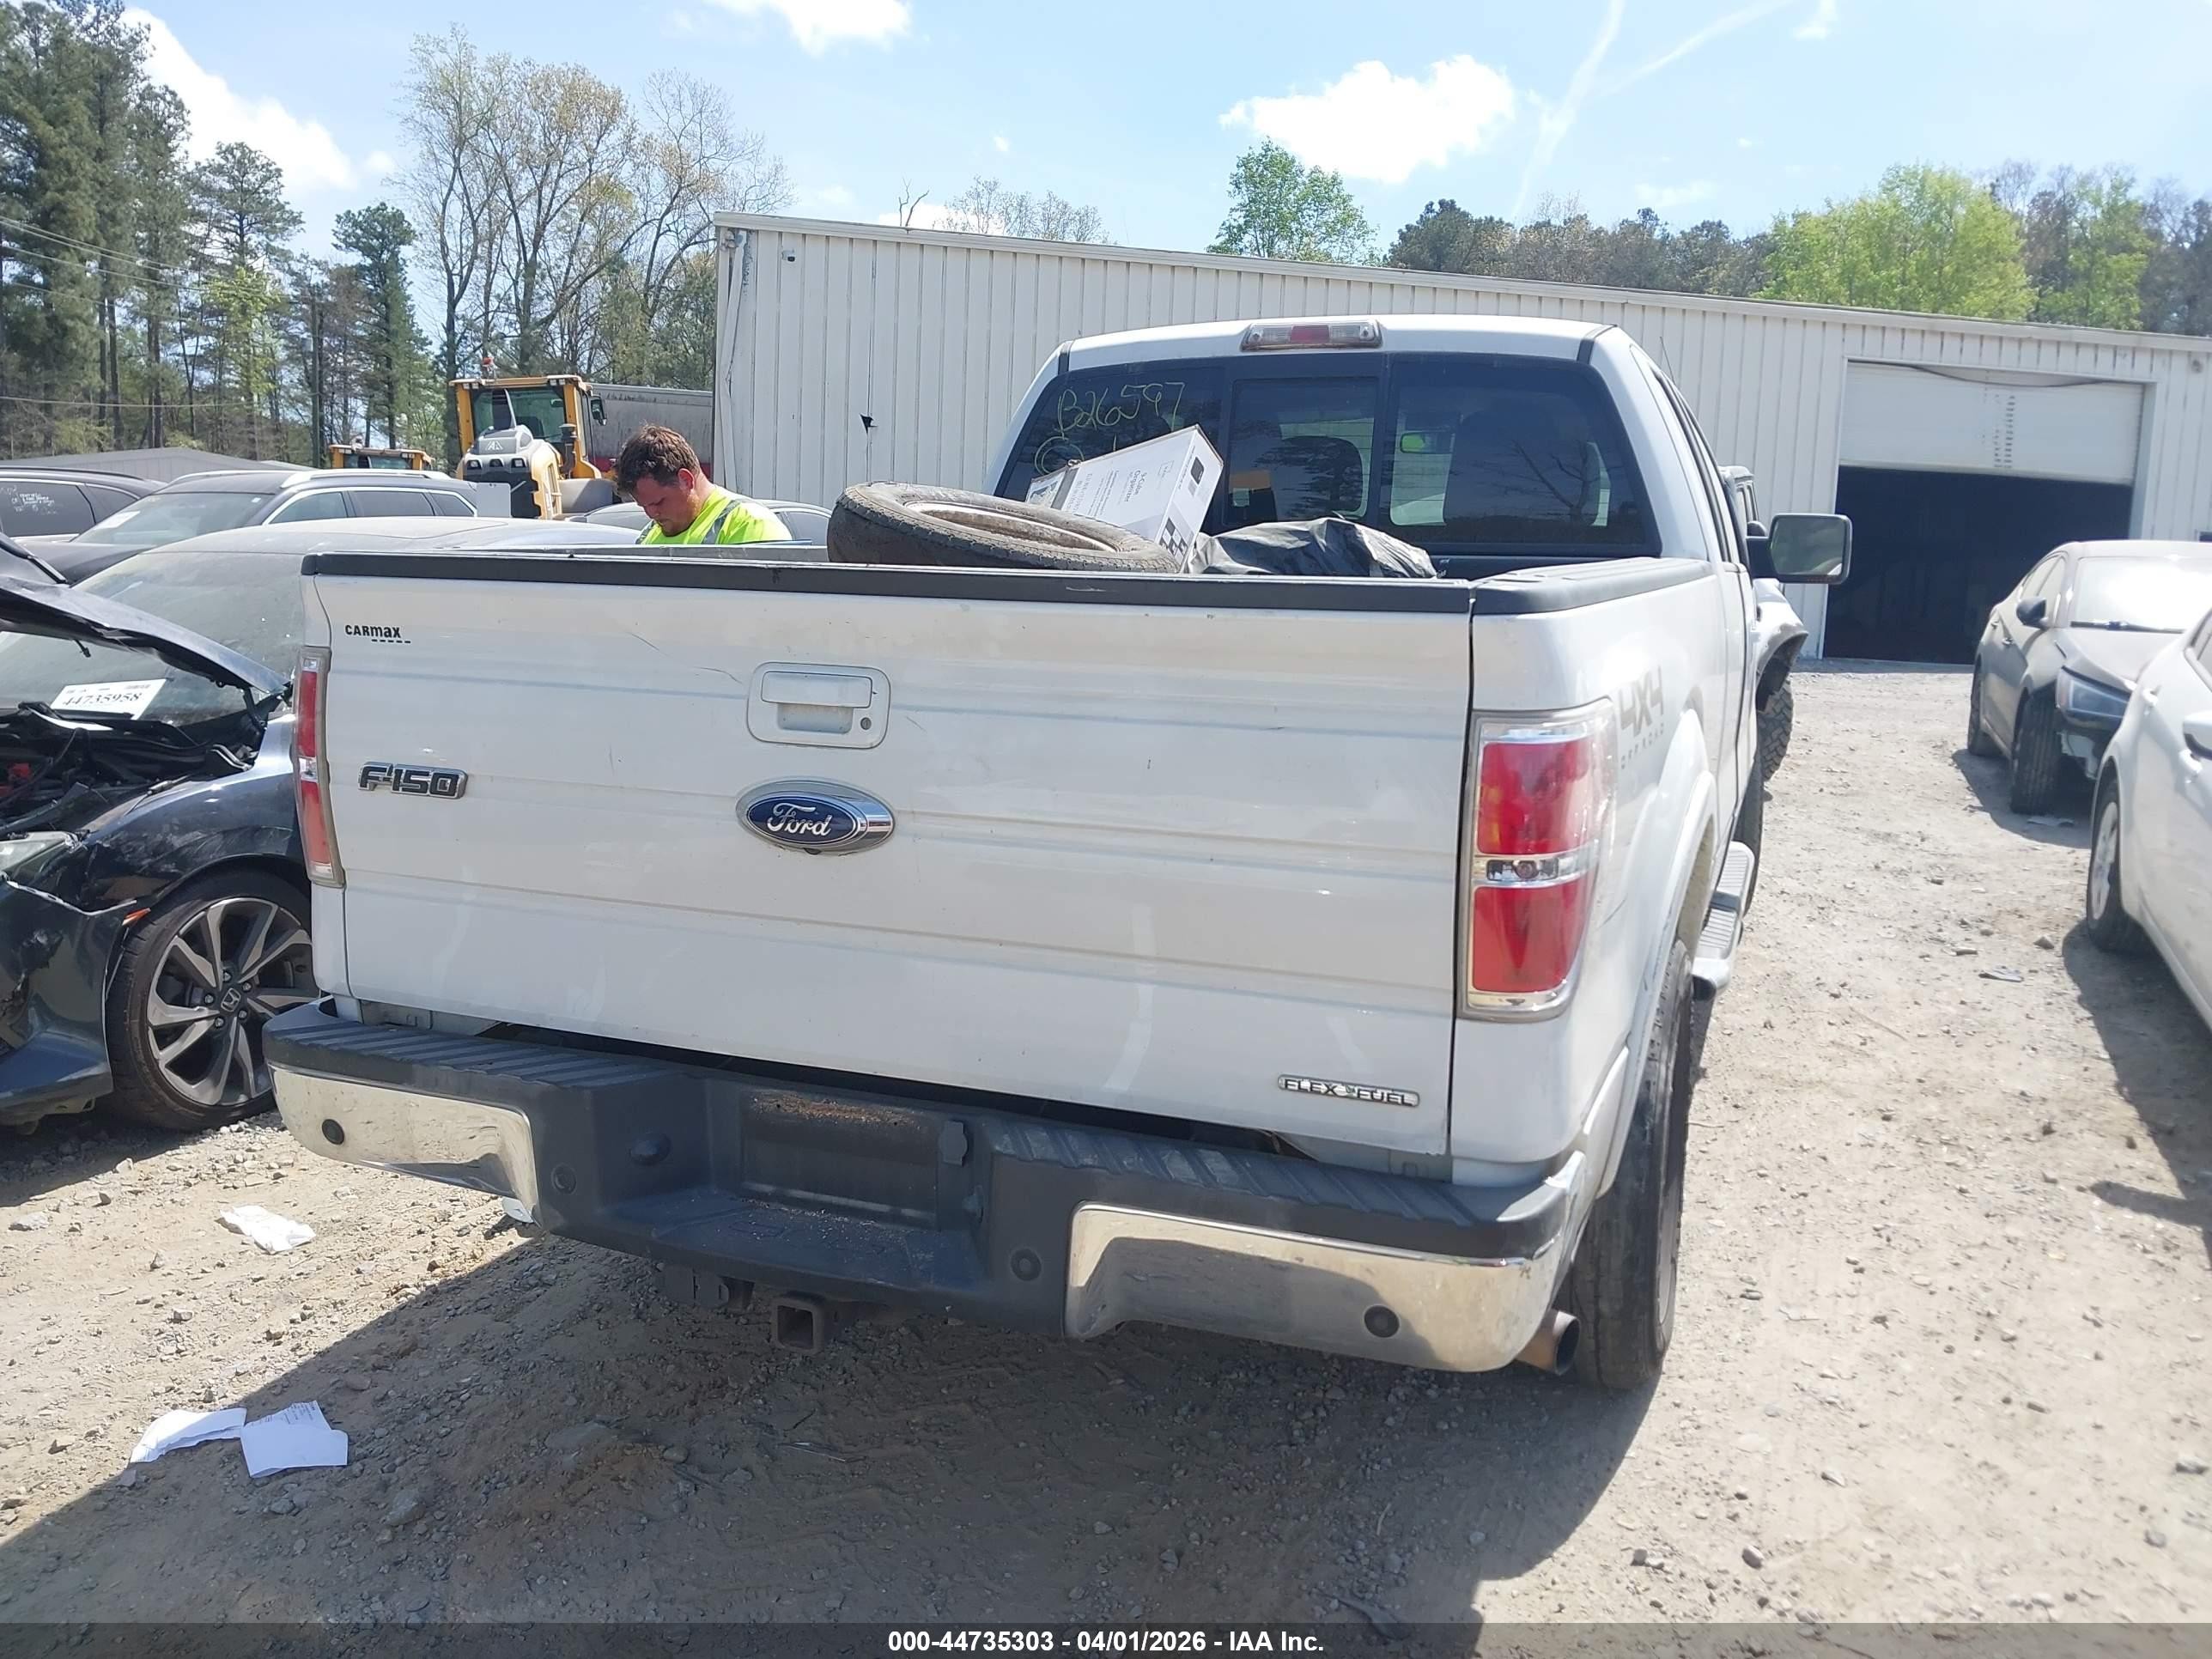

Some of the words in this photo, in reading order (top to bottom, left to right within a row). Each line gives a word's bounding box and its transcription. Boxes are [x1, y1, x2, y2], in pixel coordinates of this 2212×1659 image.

[1056, 381, 1186, 440] B26597
[63, 692, 143, 706] 44735958
[358, 761, 469, 800] F-150
[767, 802, 832, 836] Ford
[1283, 1078, 1338, 1098] FLEX
[1355, 1087, 1414, 1108] FUEL
